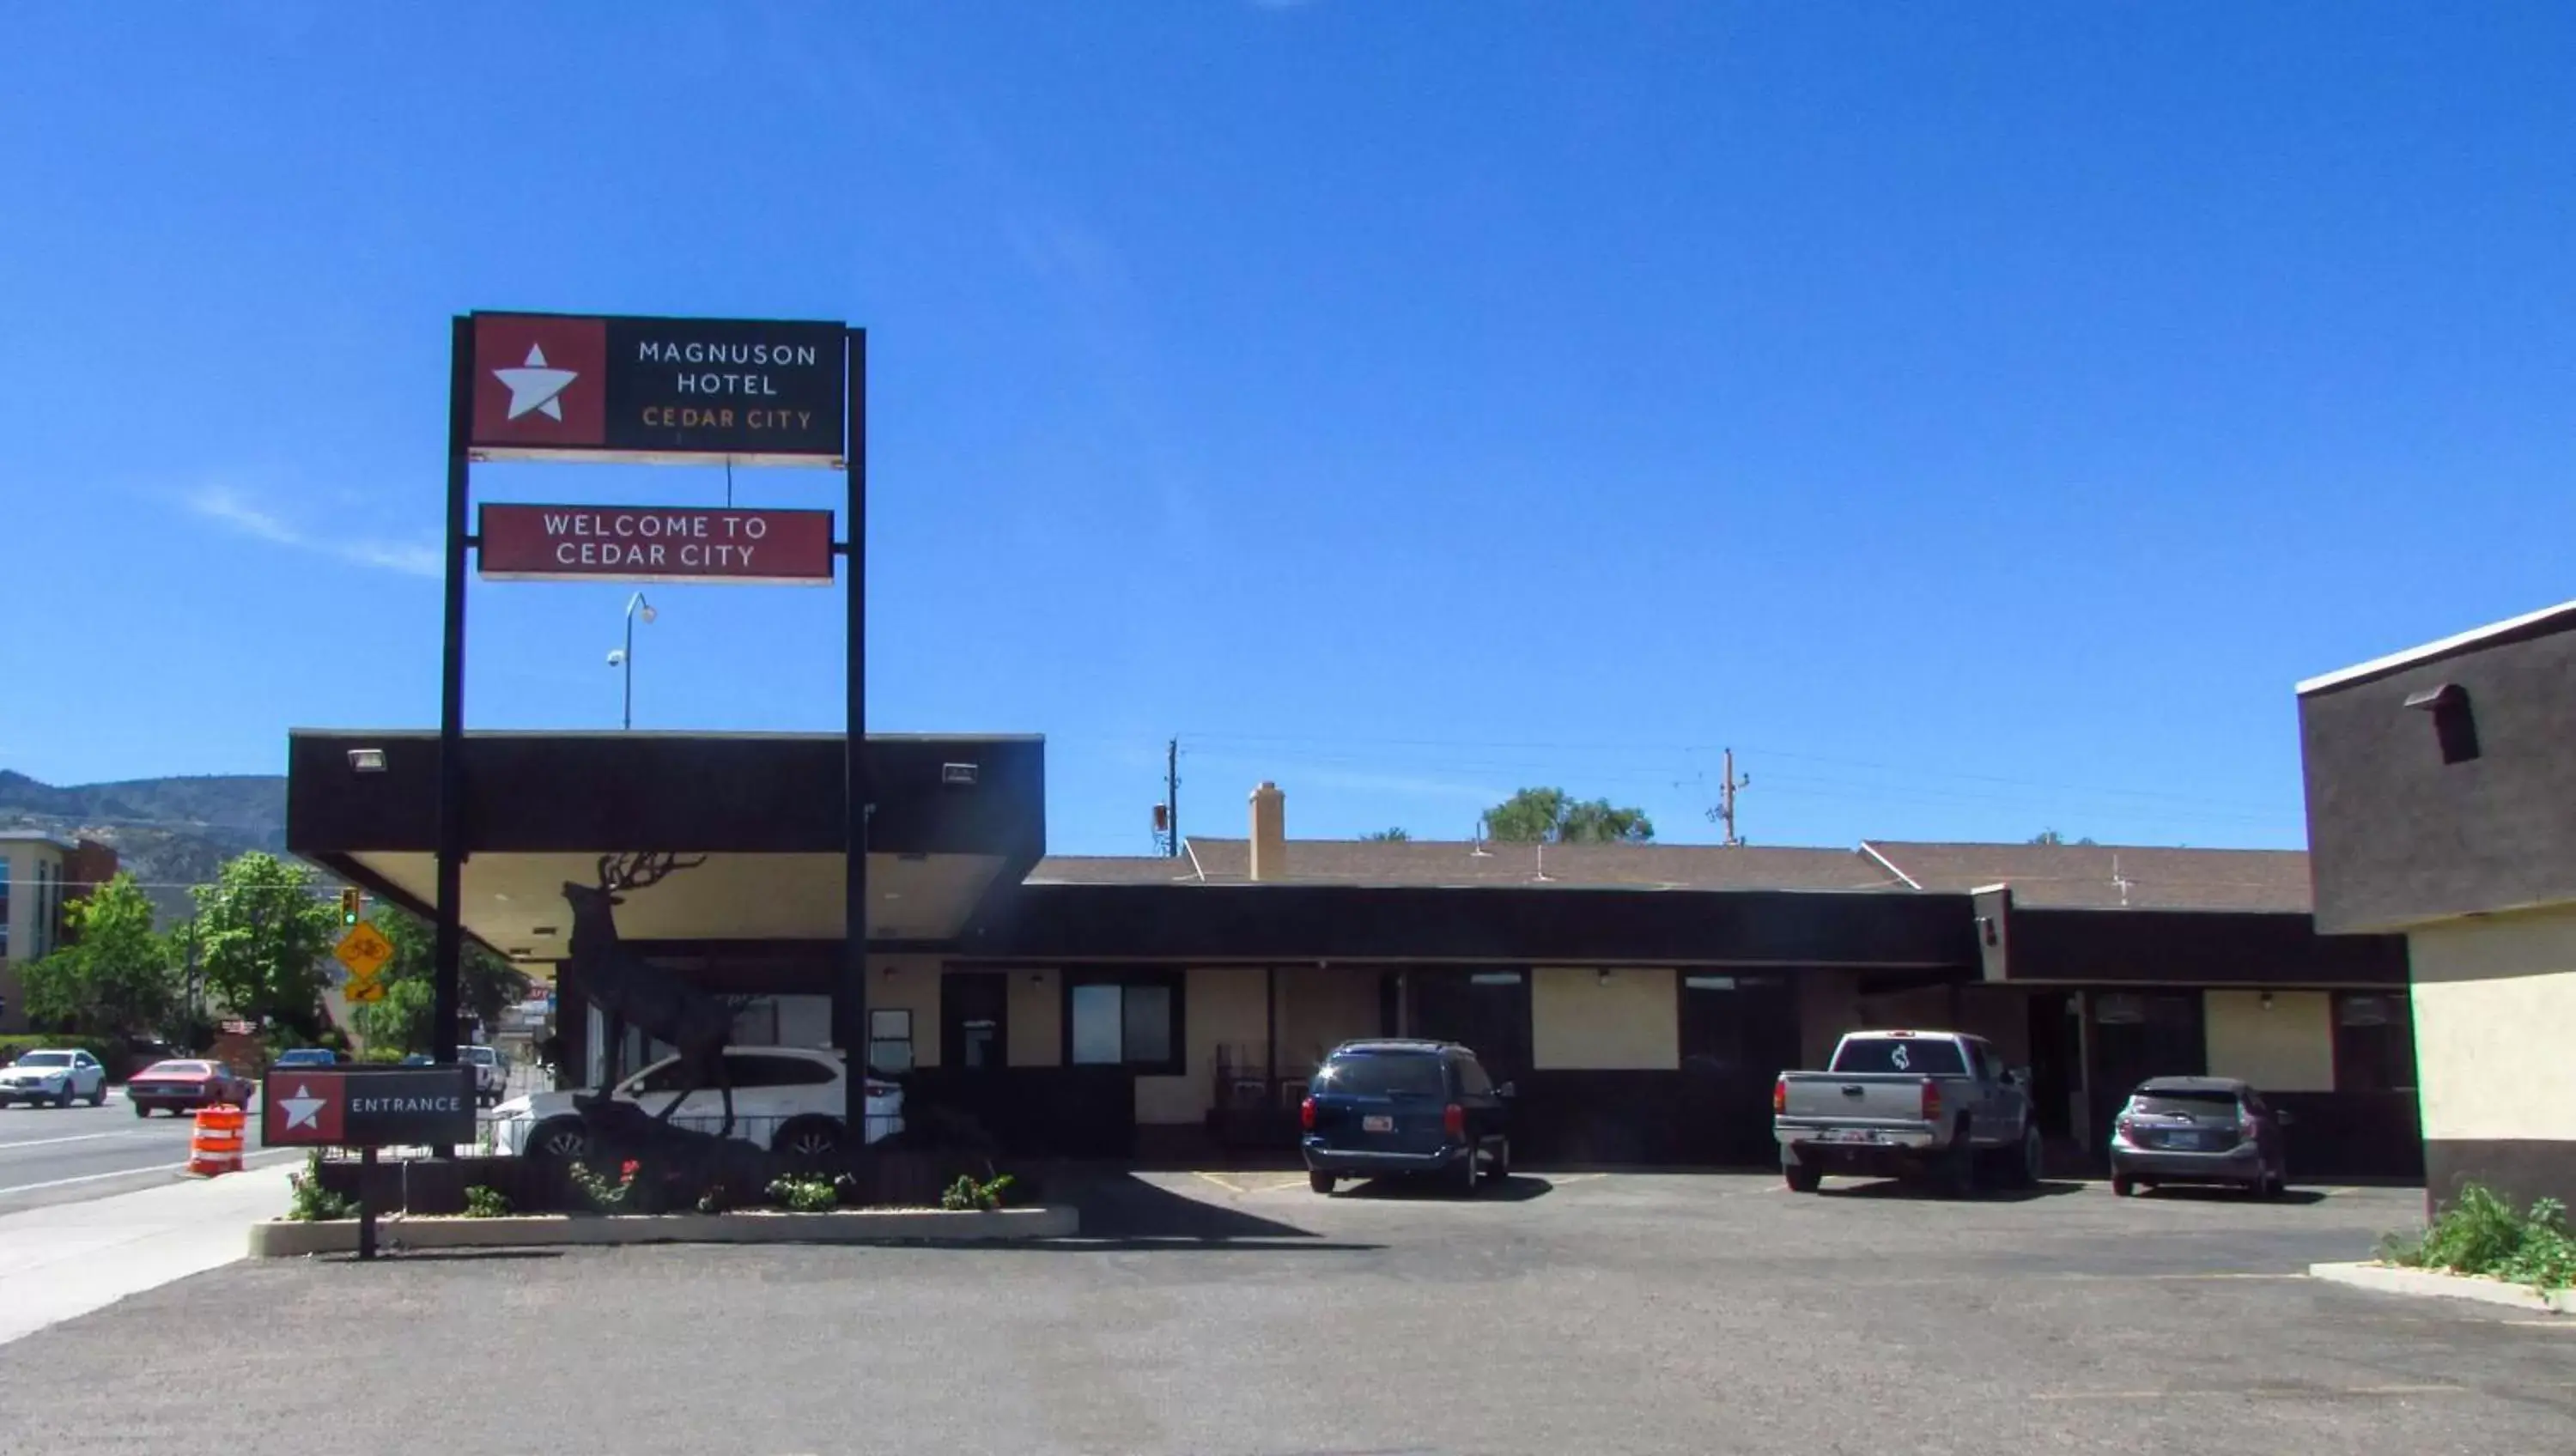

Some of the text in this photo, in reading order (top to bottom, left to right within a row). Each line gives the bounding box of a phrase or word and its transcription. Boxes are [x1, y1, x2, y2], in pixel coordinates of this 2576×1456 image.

[638, 341, 816, 366] MAGNUSON
[677, 372, 777, 395] HOTEL
[642, 406, 811, 429] CEDAR CITY
[544, 513, 767, 539] WELCOME TO
[556, 543, 755, 567] CEDAR CITY
[351, 1097, 462, 1113] ENTRANCE
